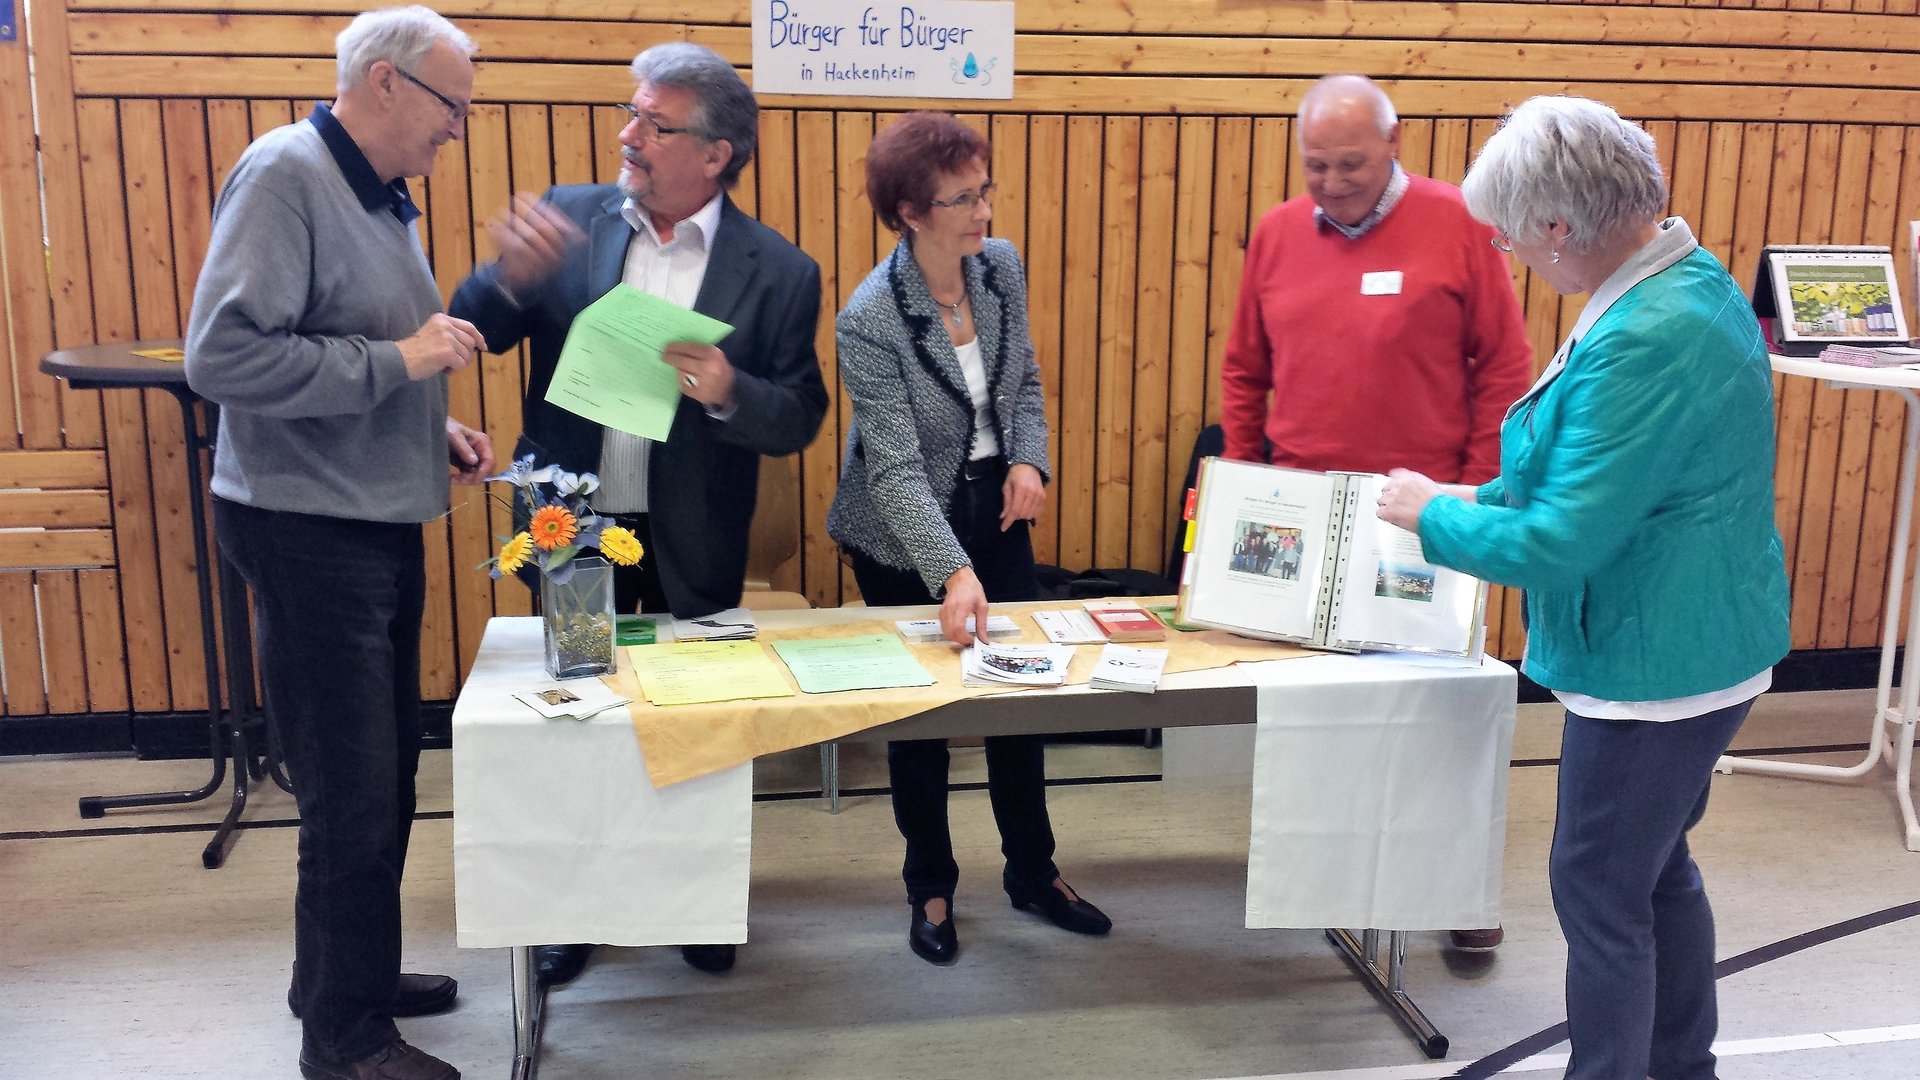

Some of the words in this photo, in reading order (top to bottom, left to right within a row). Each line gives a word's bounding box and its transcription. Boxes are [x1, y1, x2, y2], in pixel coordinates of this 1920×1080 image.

[770, 0, 845, 51] Bürger
[859, 7, 890, 46] für
[901, 7, 974, 50] Bürger
[801, 63, 812, 81] in
[825, 62, 916, 81] Hackenheim
